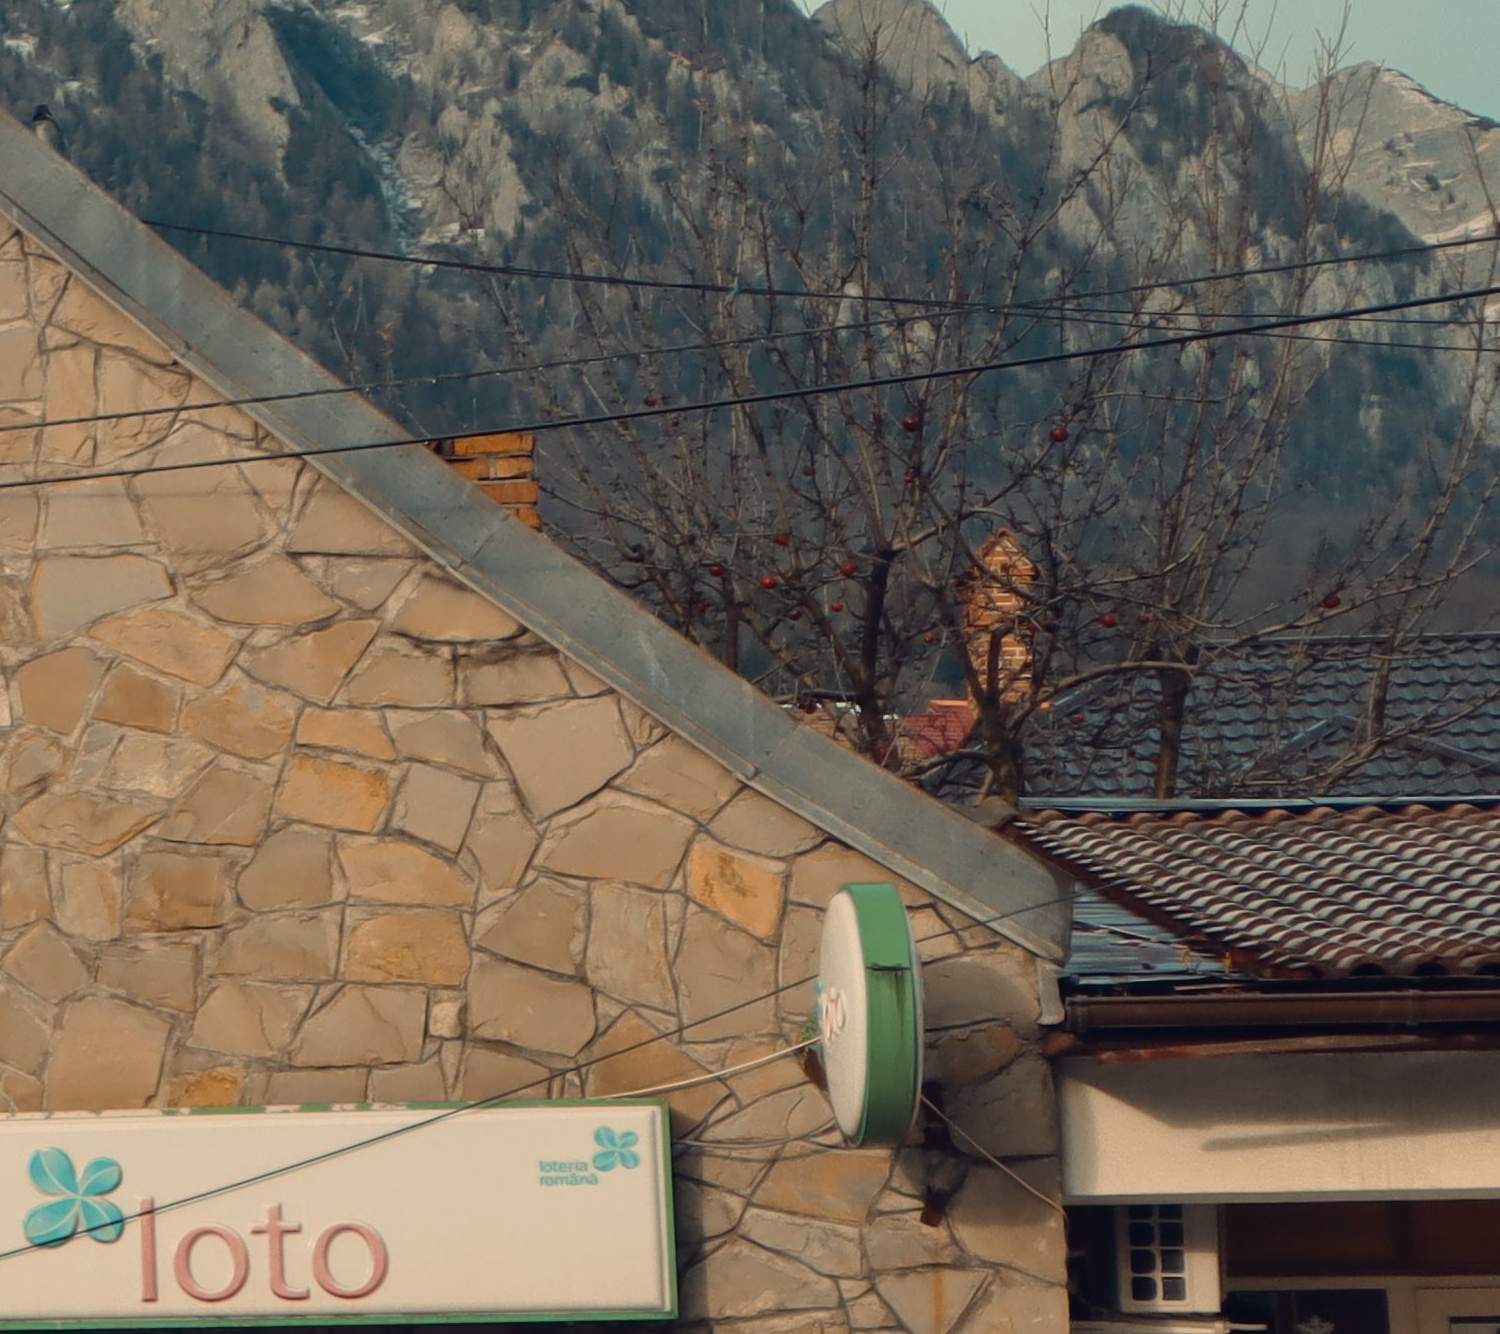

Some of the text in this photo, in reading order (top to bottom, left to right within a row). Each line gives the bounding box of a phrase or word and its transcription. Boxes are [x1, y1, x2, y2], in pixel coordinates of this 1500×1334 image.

[540, 1160, 587, 1172] loteria
[540, 1172, 598, 1186] română
[140, 1197, 389, 1302] loto
